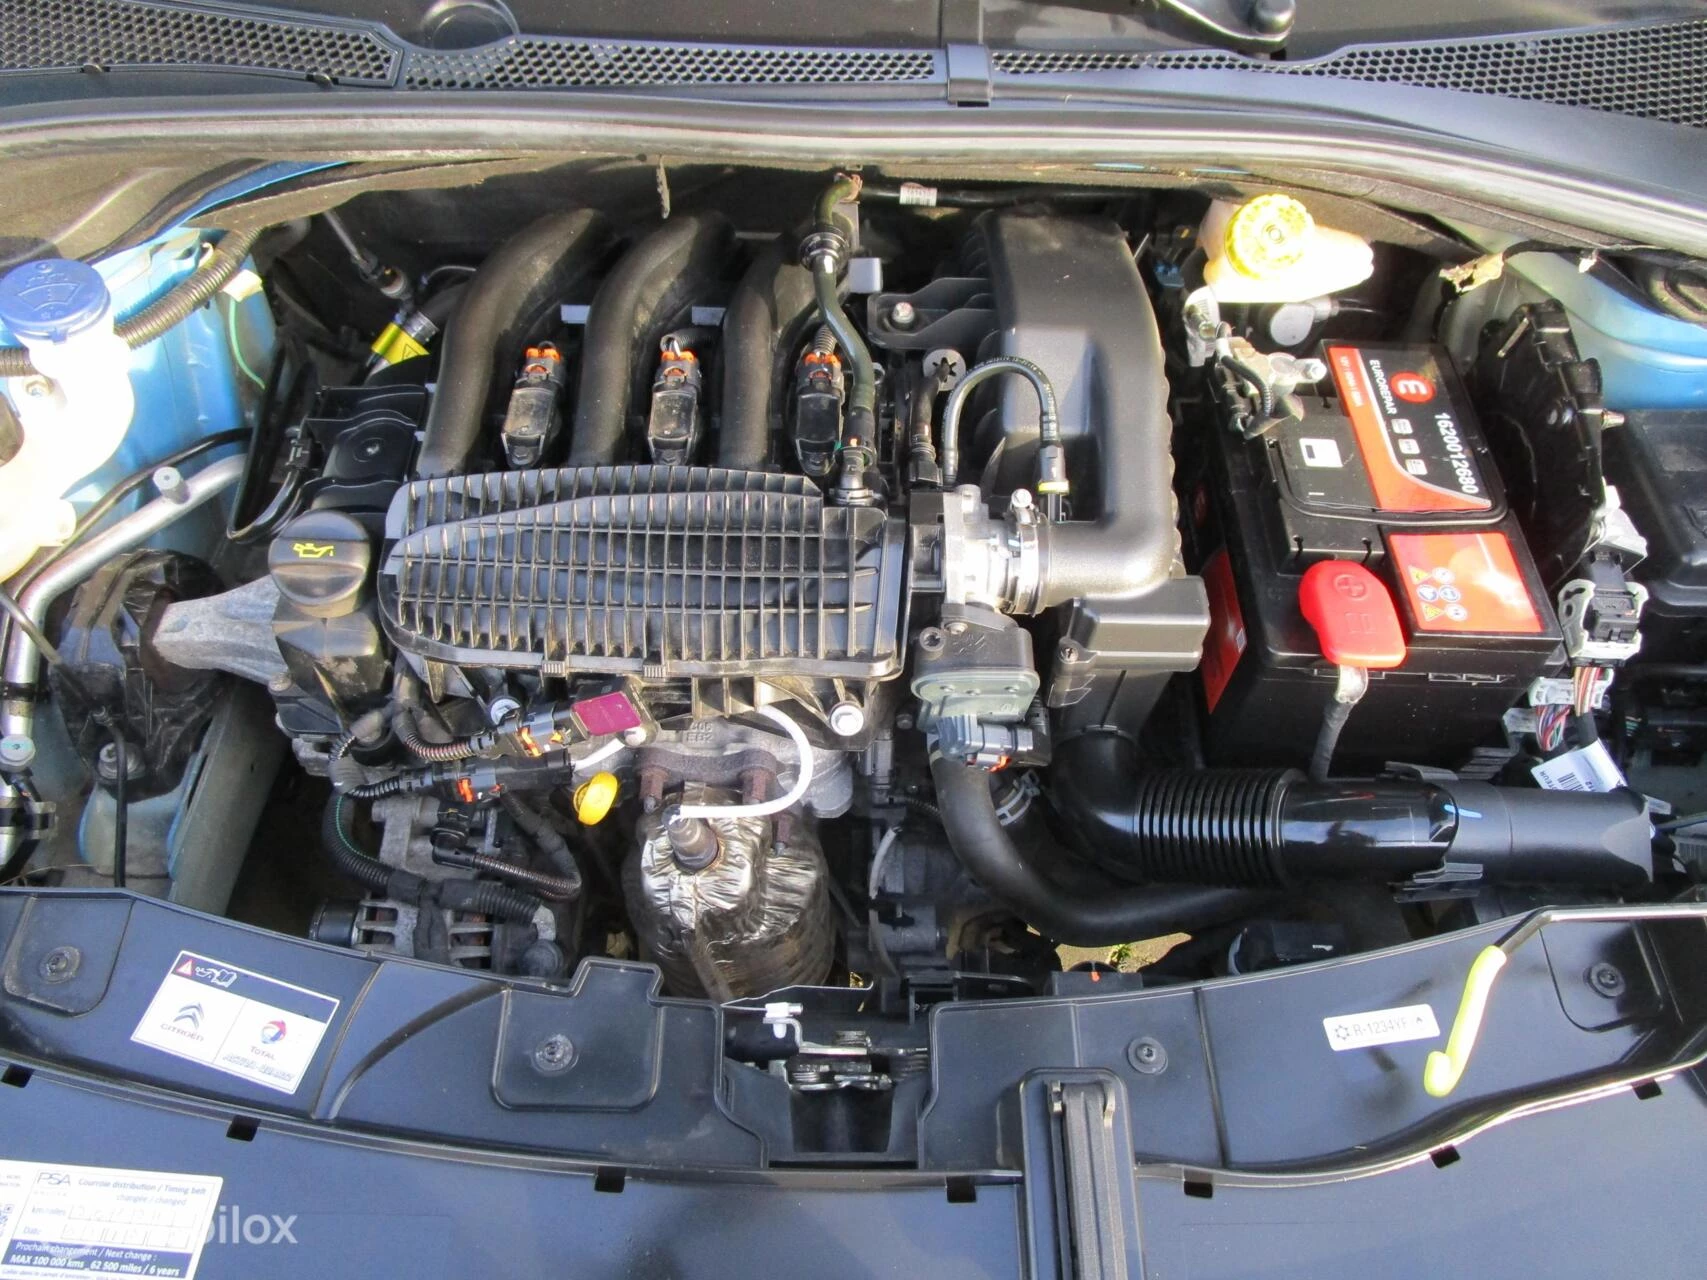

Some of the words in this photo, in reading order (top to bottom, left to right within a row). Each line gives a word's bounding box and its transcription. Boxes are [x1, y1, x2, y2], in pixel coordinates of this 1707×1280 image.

[1369, 359, 1398, 415] EUROREPAR
[1434, 412, 1479, 494] 1620012680
[1352, 1017, 1408, 1037] R-1234YF
[250, 1045, 276, 1060] TOTAL
[37, 1172, 71, 1186] PSA
[112, 1179, 156, 1191] distribution
[105, 1248, 124, 1258] Next
[124, 1250, 152, 1262] change
[10, 1254, 31, 1264] MAX
[33, 1255, 49, 1265] 100
[50, 1256, 66, 1266] 000
[67, 1258, 84, 1268] kms
[90, 1260, 101, 1270] 62
[103, 1261, 118, 1271] 500
[119, 1262, 142, 1273] miles
[149, 1265, 155, 1273] 6
[157, 1267, 180, 1277] years
